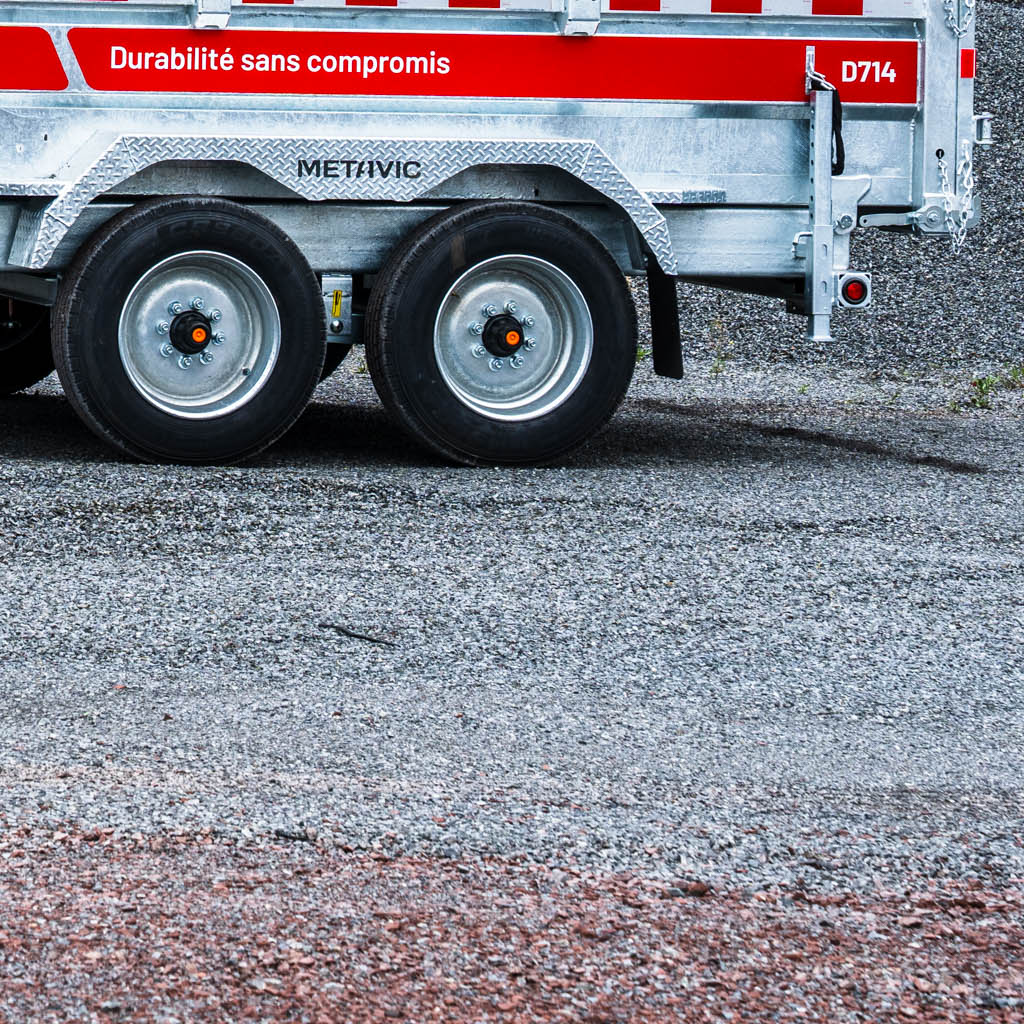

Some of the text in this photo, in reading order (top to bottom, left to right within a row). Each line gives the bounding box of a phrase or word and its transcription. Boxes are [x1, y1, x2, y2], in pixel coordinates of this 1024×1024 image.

[110, 45, 451, 79] Durabilité sans compromis
[841, 60, 897, 83] D714
[297, 159, 422, 179] METAVIC
